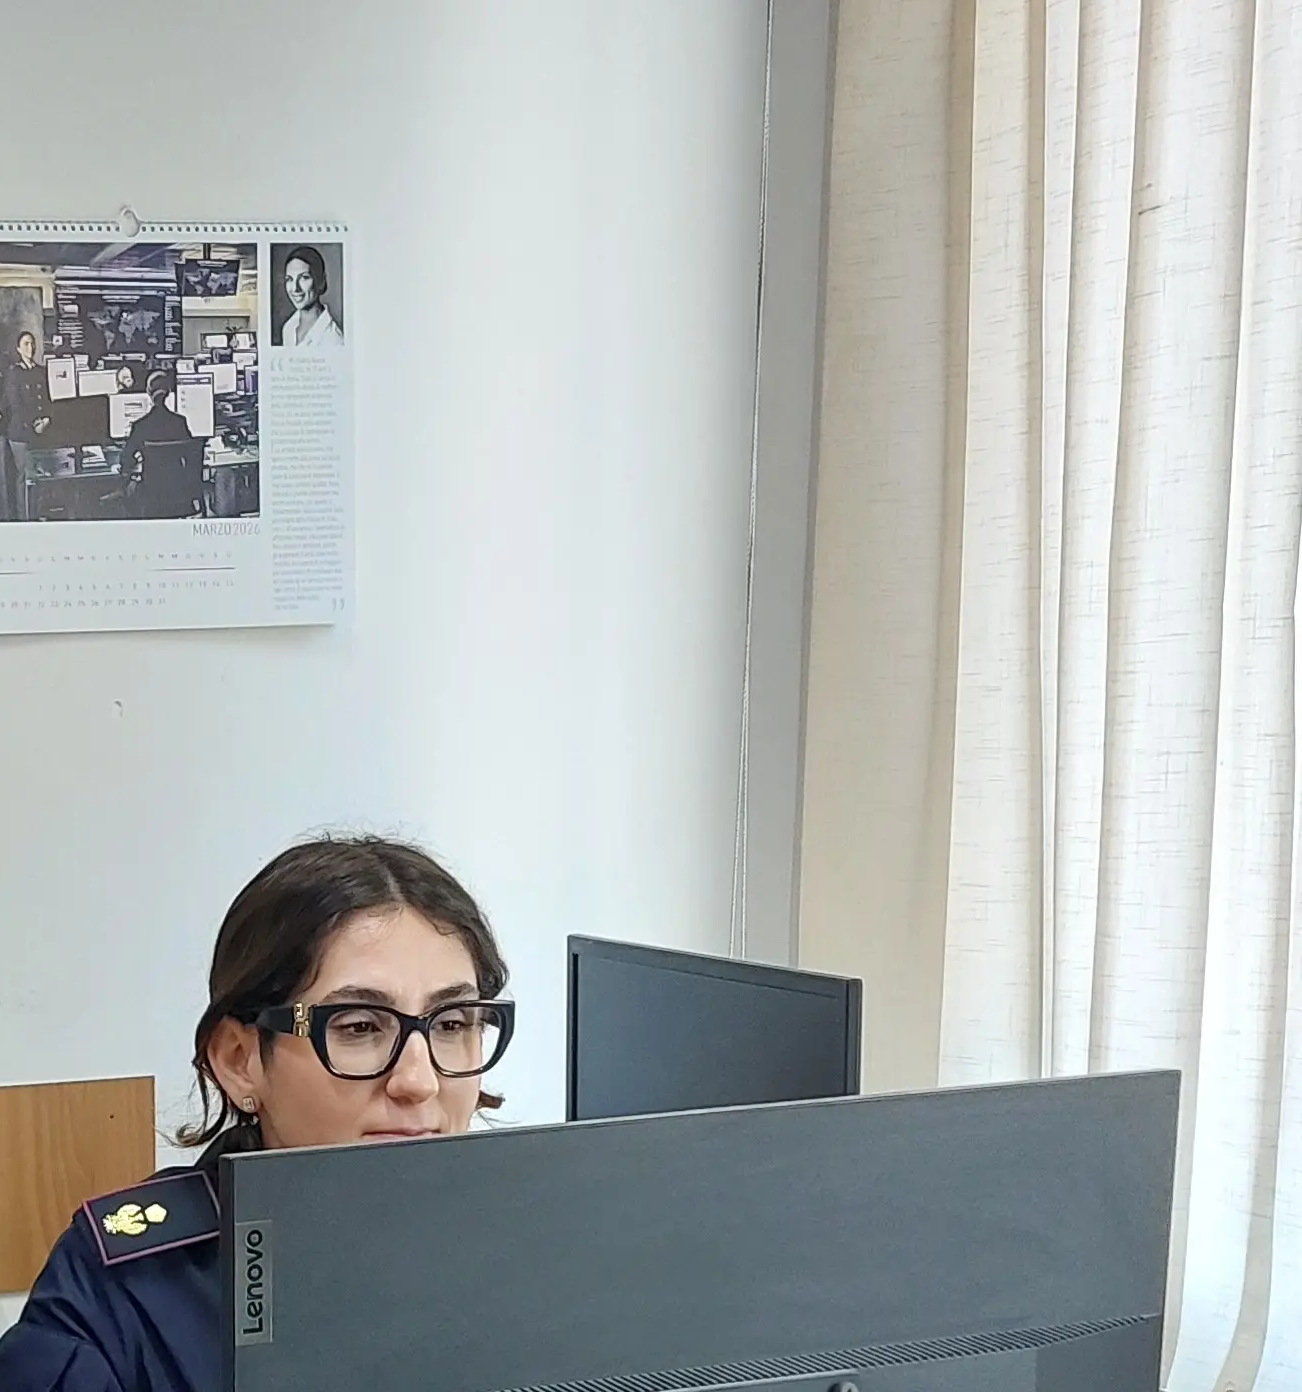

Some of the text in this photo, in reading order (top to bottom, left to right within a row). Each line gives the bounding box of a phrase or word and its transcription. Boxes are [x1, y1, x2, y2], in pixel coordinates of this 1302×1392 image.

[193, 522, 260, 536] MARZO 2026
[243, 1229, 264, 1335] Lenovo
